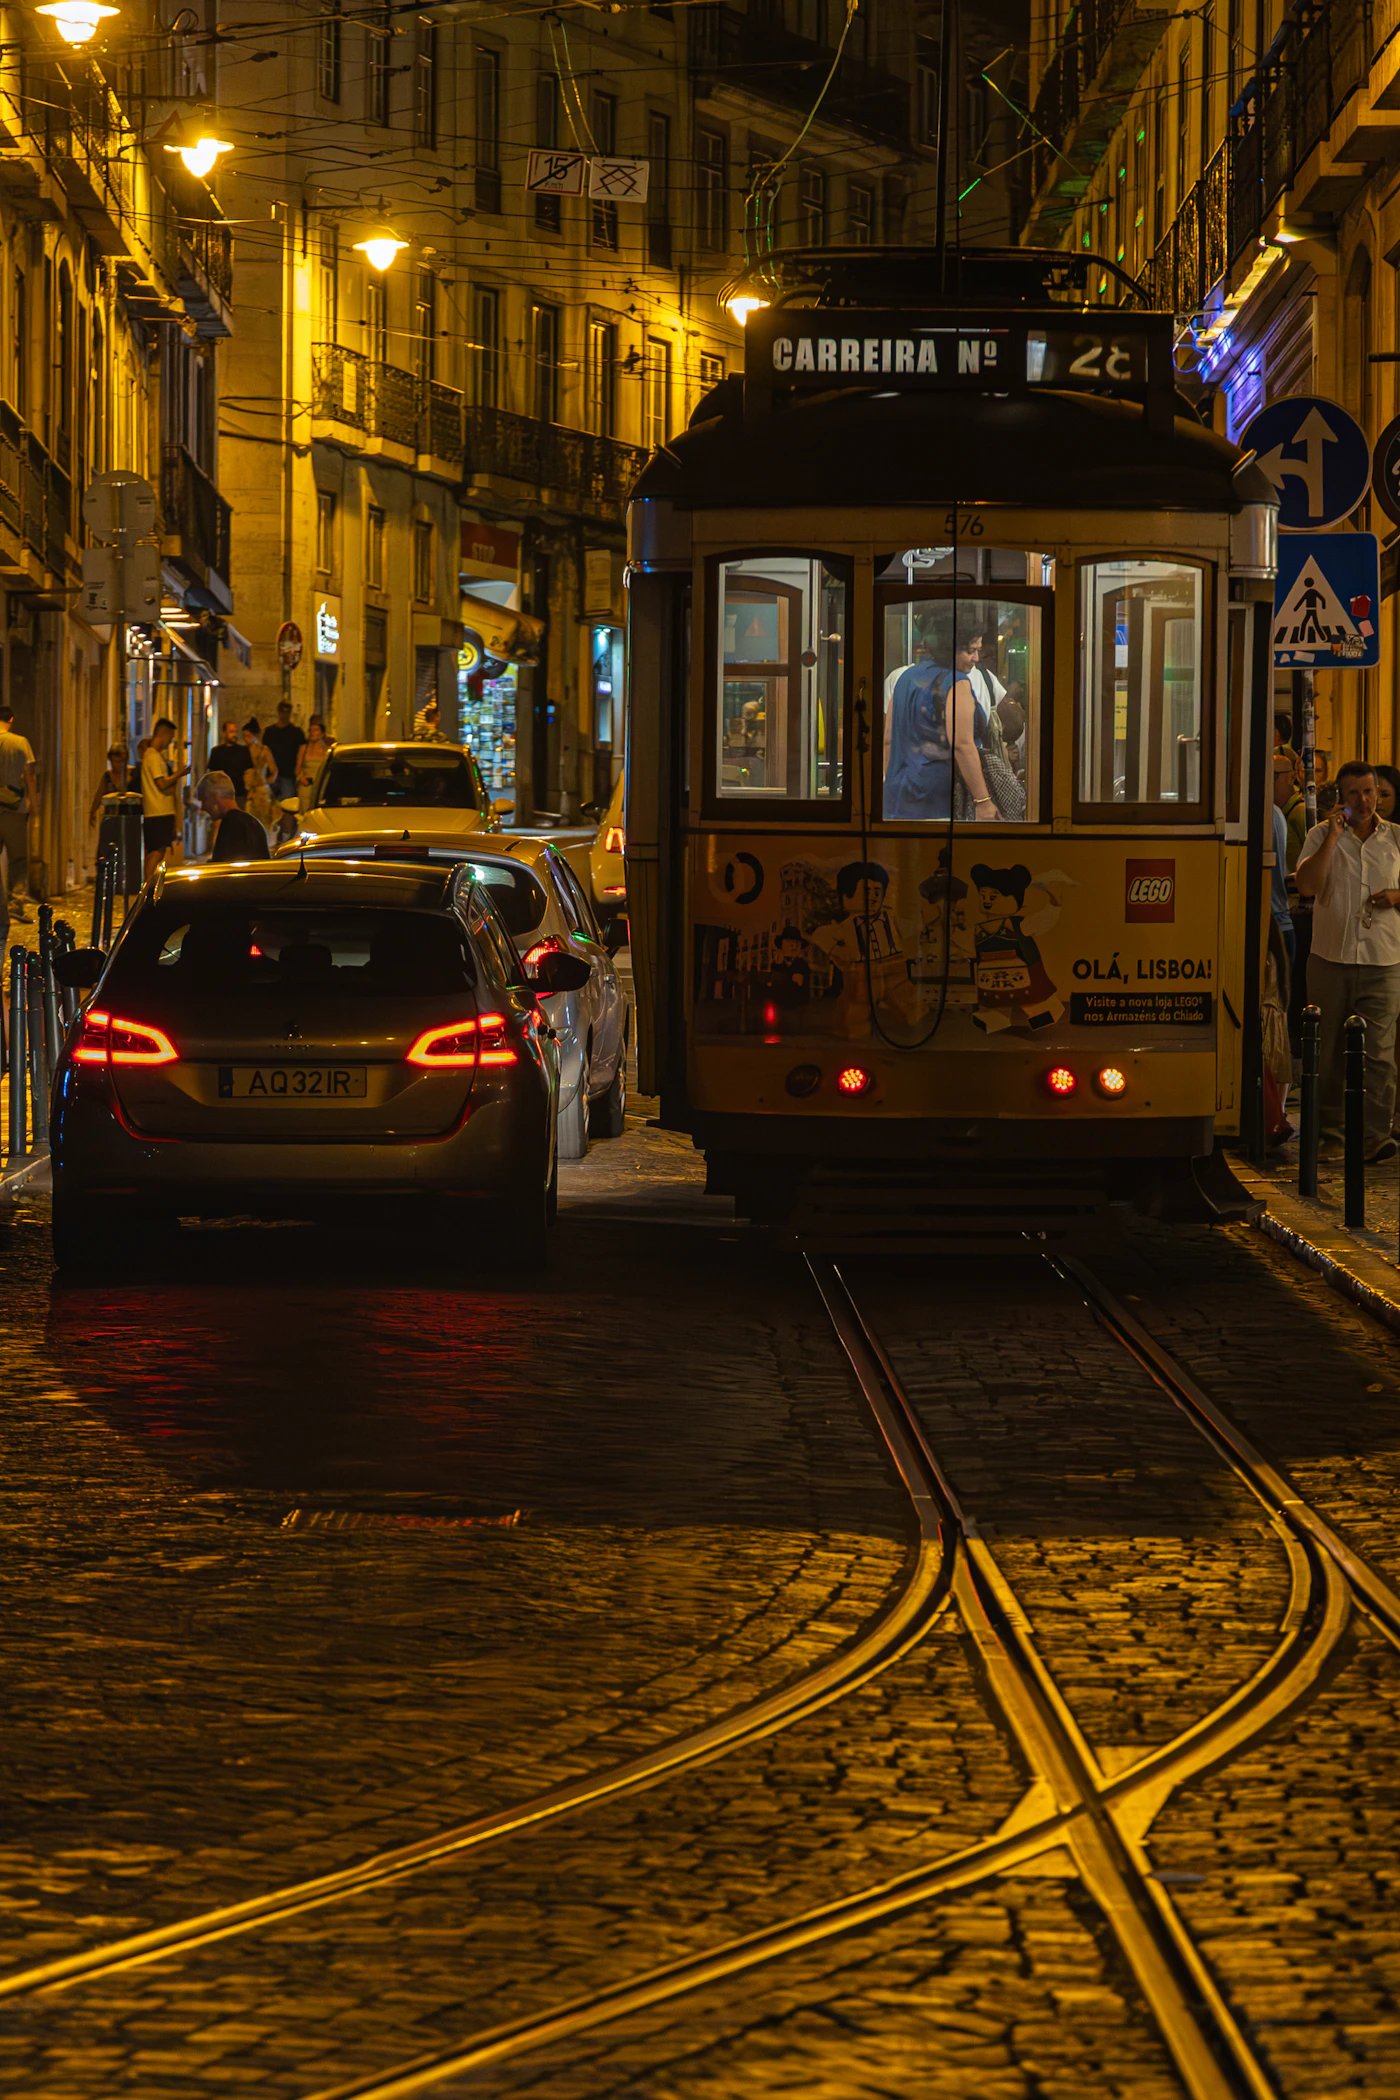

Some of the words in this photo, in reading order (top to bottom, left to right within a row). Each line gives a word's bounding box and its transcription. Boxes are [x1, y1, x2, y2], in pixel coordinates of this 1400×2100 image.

[544, 156, 568, 180] 15
[772, 337, 938, 373] CARREIRA
[957, 339, 998, 374] Nº
[944, 513, 984, 536] 576
[1129, 877, 1172, 903] LEGO
[1072, 952, 1129, 984] OLÁ,
[1137, 959, 1212, 980] LISBOA!
[1085, 995, 1117, 1008] Visite
[1119, 998, 1126, 1008] a
[1128, 998, 1153, 1008] nova
[1155, 995, 1172, 1010] loja
[1084, 1011, 1104, 1022] nos
[1106, 1009, 1156, 1022] Armazéns
[1158, 1010, 1171, 1022] do
[1173, 1009, 1204, 1022] Chiado
